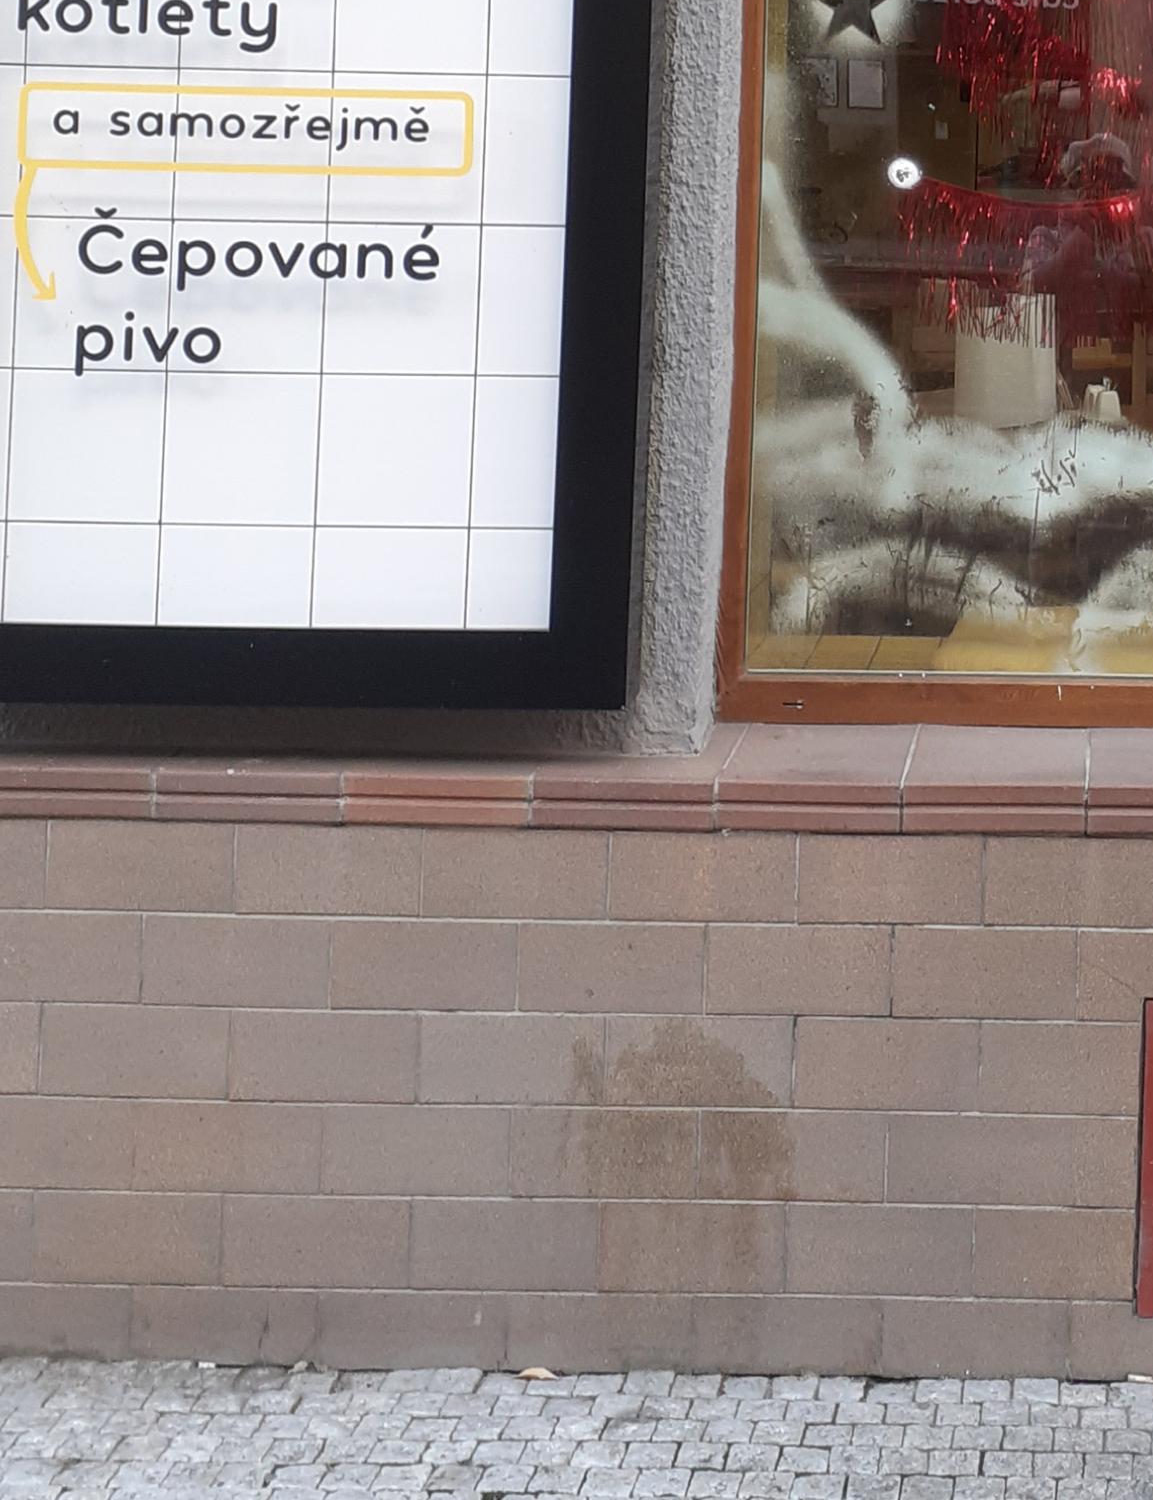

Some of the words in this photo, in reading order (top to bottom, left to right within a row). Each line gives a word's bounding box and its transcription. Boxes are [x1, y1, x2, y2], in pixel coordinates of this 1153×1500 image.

[53, 108, 80, 135] a
[109, 103, 430, 152] samozřejmě
[78, 206, 440, 290] Čepované
[75, 311, 221, 376] pivo
